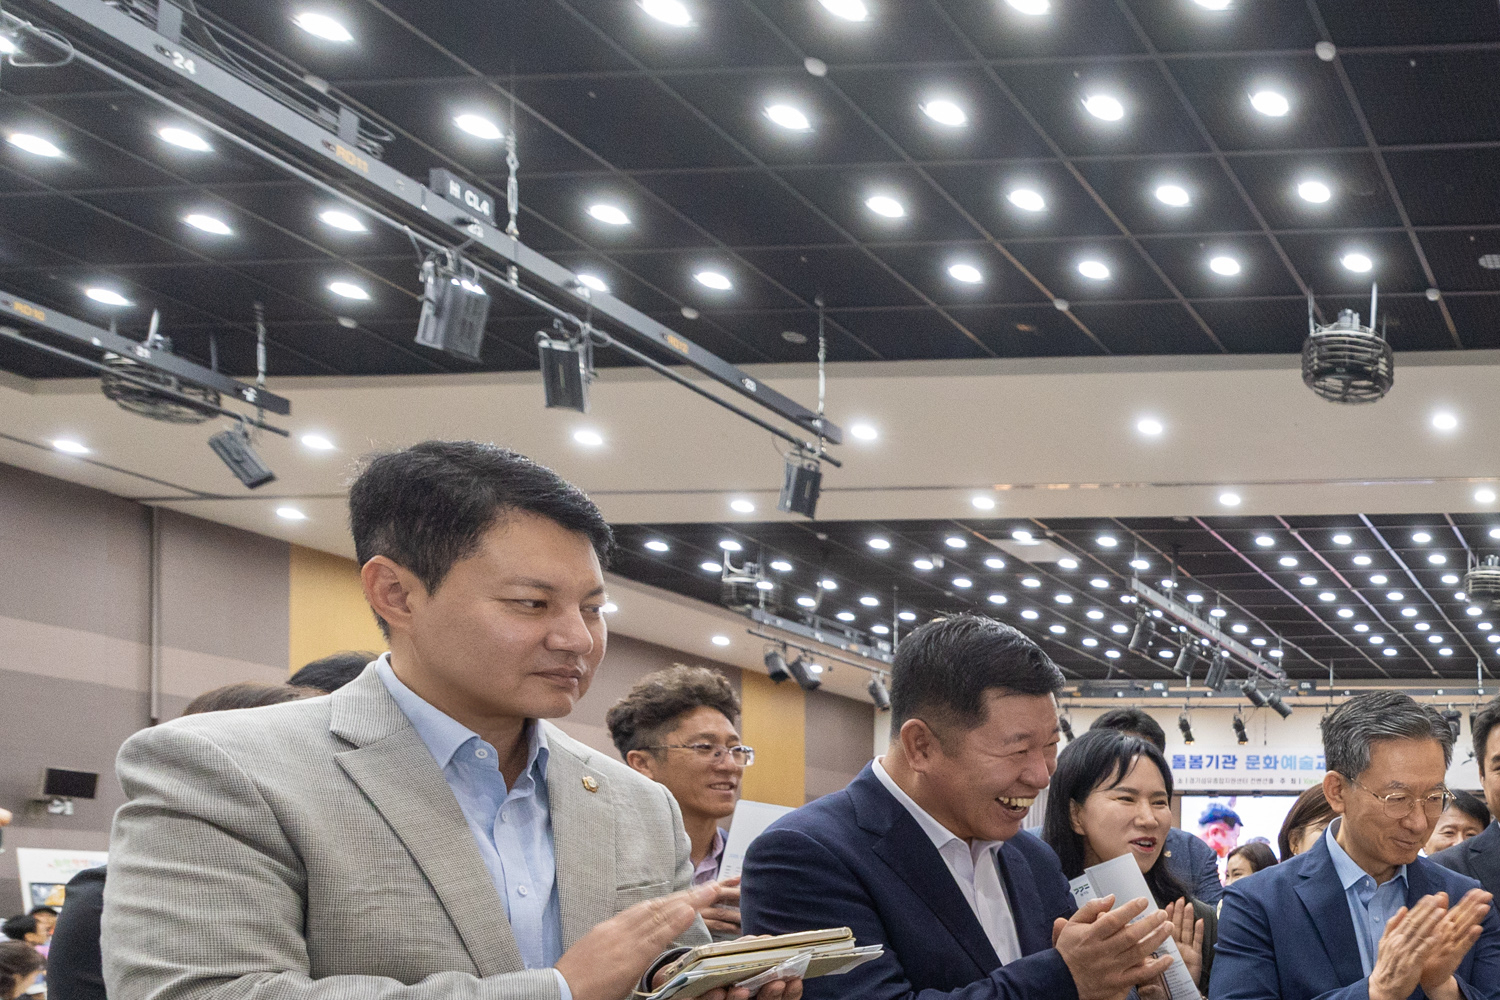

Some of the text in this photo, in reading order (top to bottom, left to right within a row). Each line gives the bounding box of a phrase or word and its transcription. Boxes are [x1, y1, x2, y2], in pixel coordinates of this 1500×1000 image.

[171, 51, 197, 75] 24
[464, 189, 490, 217] CL4
[1172, 754, 1238, 770] 돌봄기관
